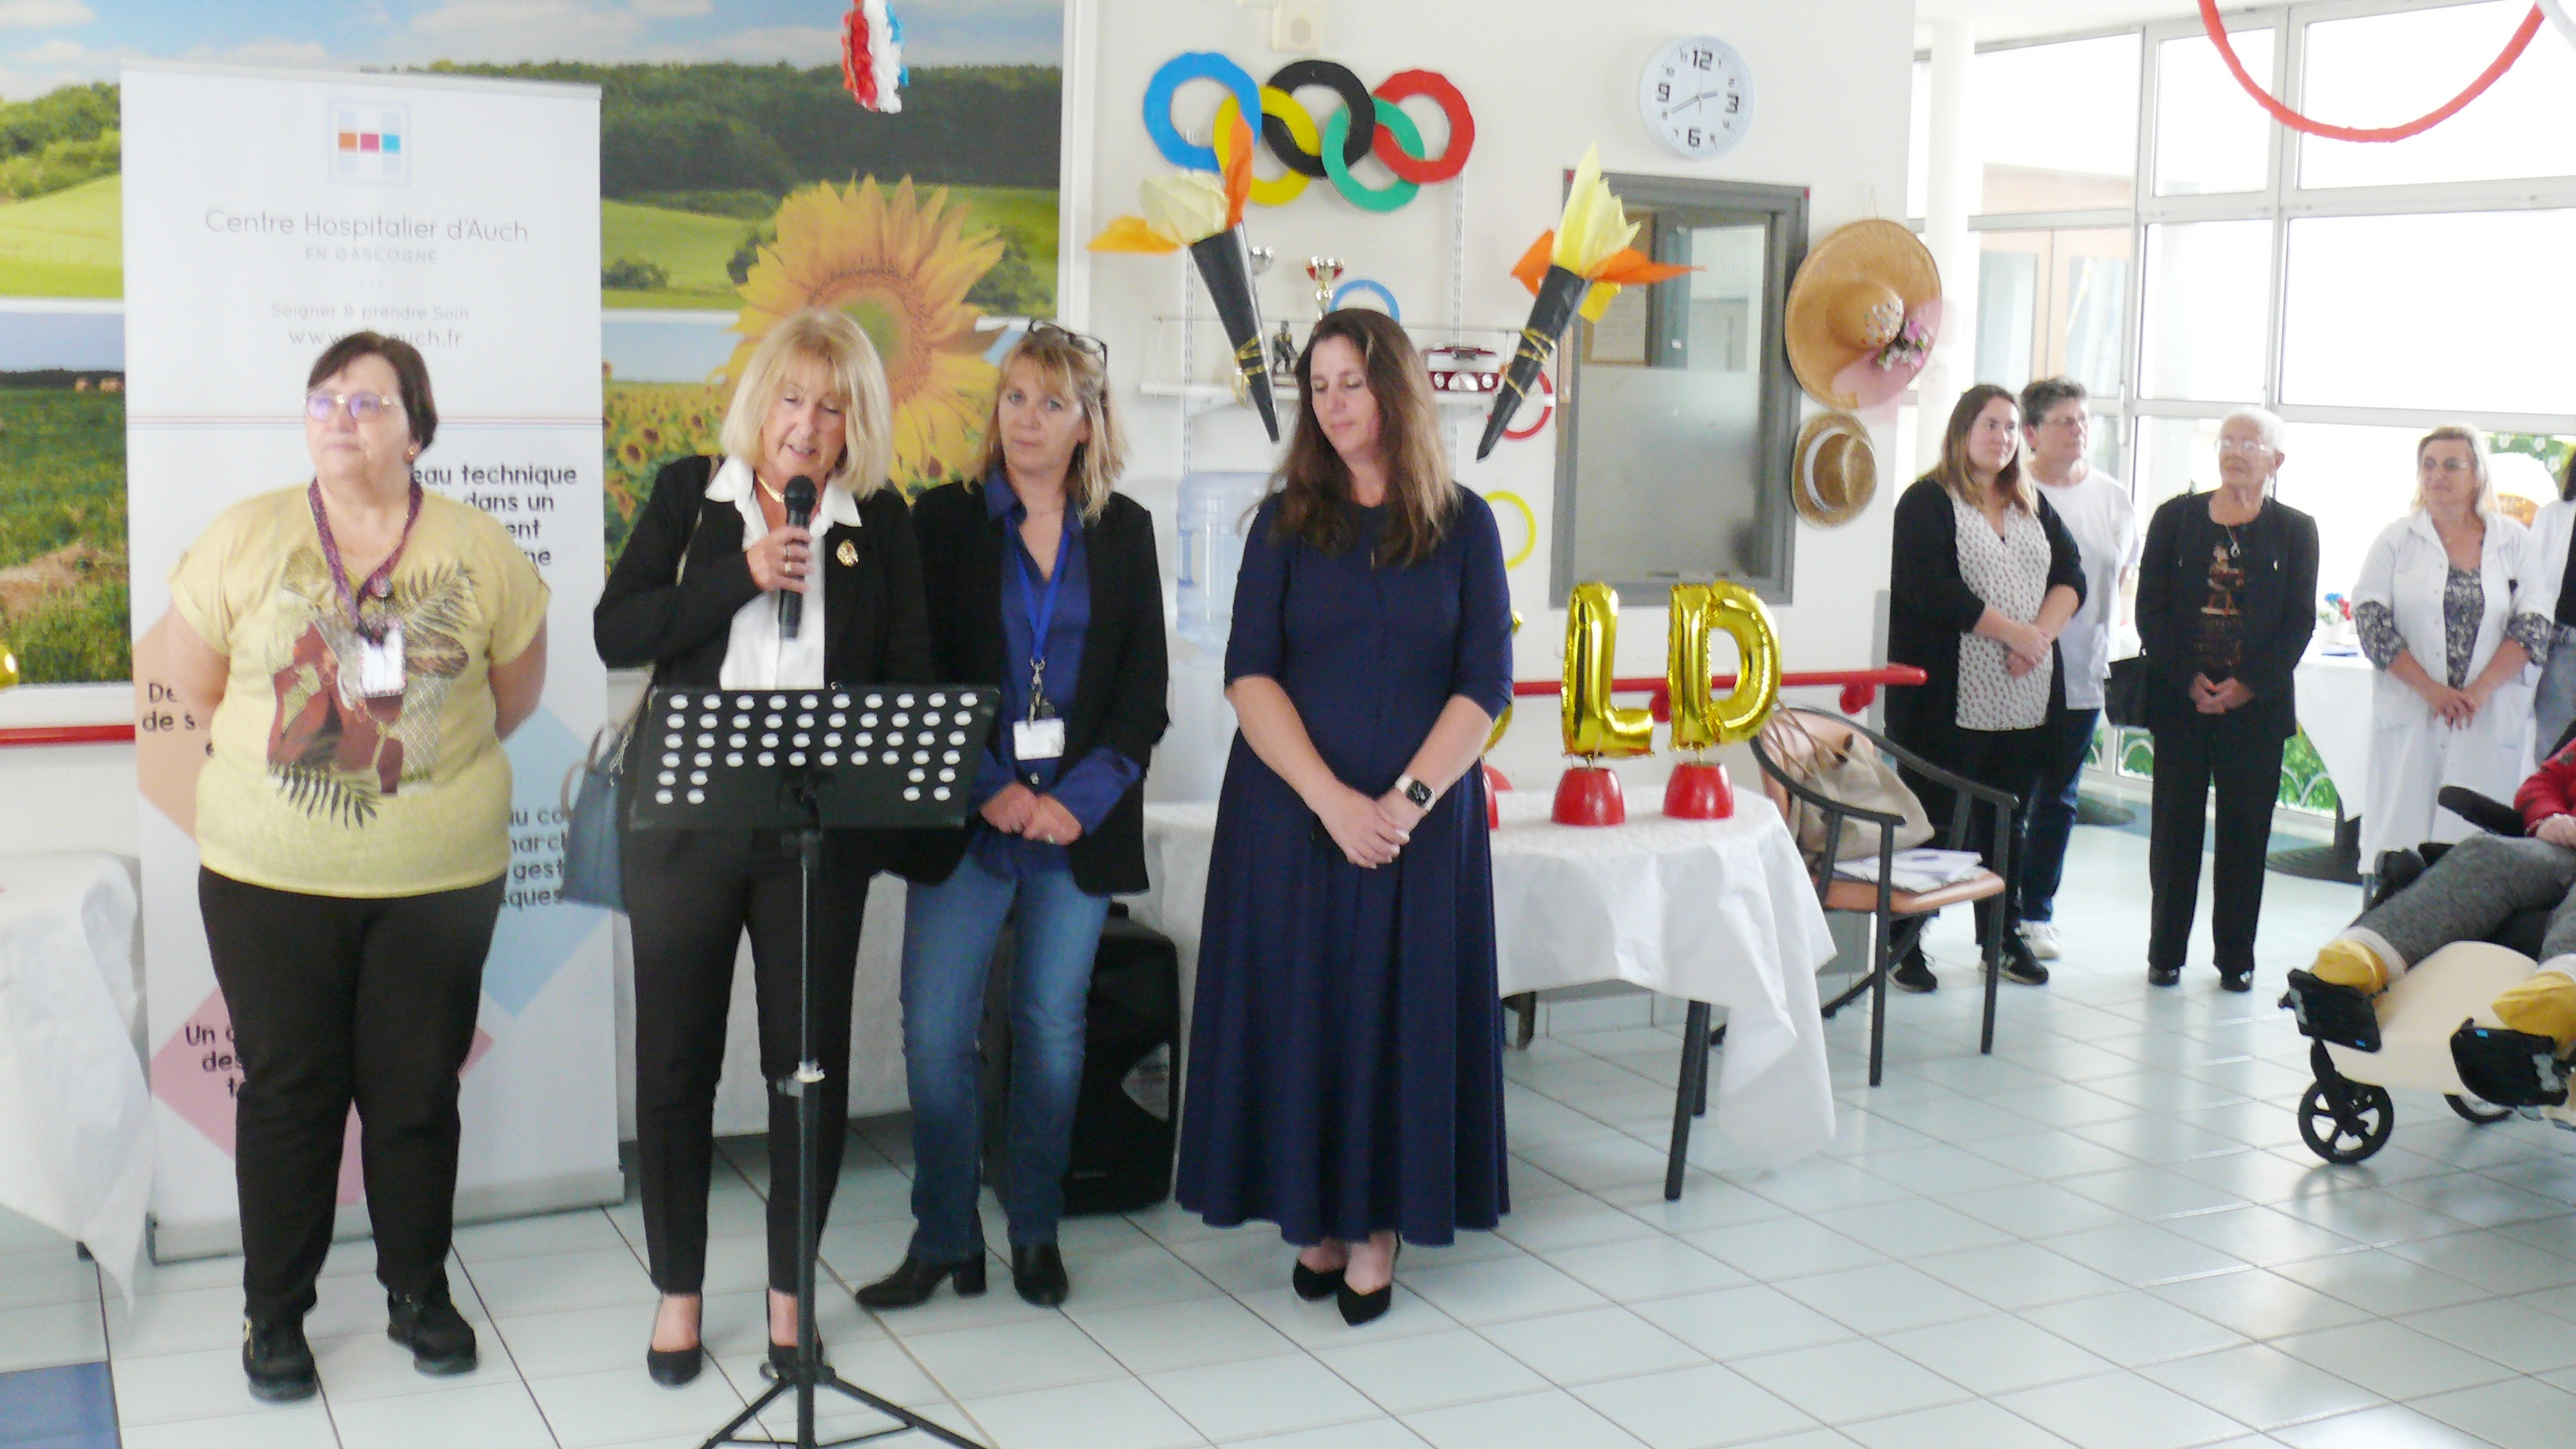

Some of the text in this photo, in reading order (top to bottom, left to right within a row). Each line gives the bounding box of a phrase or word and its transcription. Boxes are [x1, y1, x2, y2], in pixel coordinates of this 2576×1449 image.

[1692, 50, 1714, 70] 12
[1657, 82, 1670, 102] 9
[1725, 93, 1739, 114] 3
[1688, 127, 1701, 147] 6
[206, 208, 528, 243] Centre Hospitalier d'Auch
[305, 247, 438, 264] EN GASCOGNE
[270, 303, 336, 321] Soigner
[362, 305, 427, 321] prendre
[433, 306, 469, 321] Soin
[411, 462, 578, 489] eau technique
[464, 492, 555, 512] dans un
[505, 520, 541, 540] ent
[149, 682, 178, 704] De
[142, 710, 196, 732] de s
[185, 1024, 216, 1046] Un
